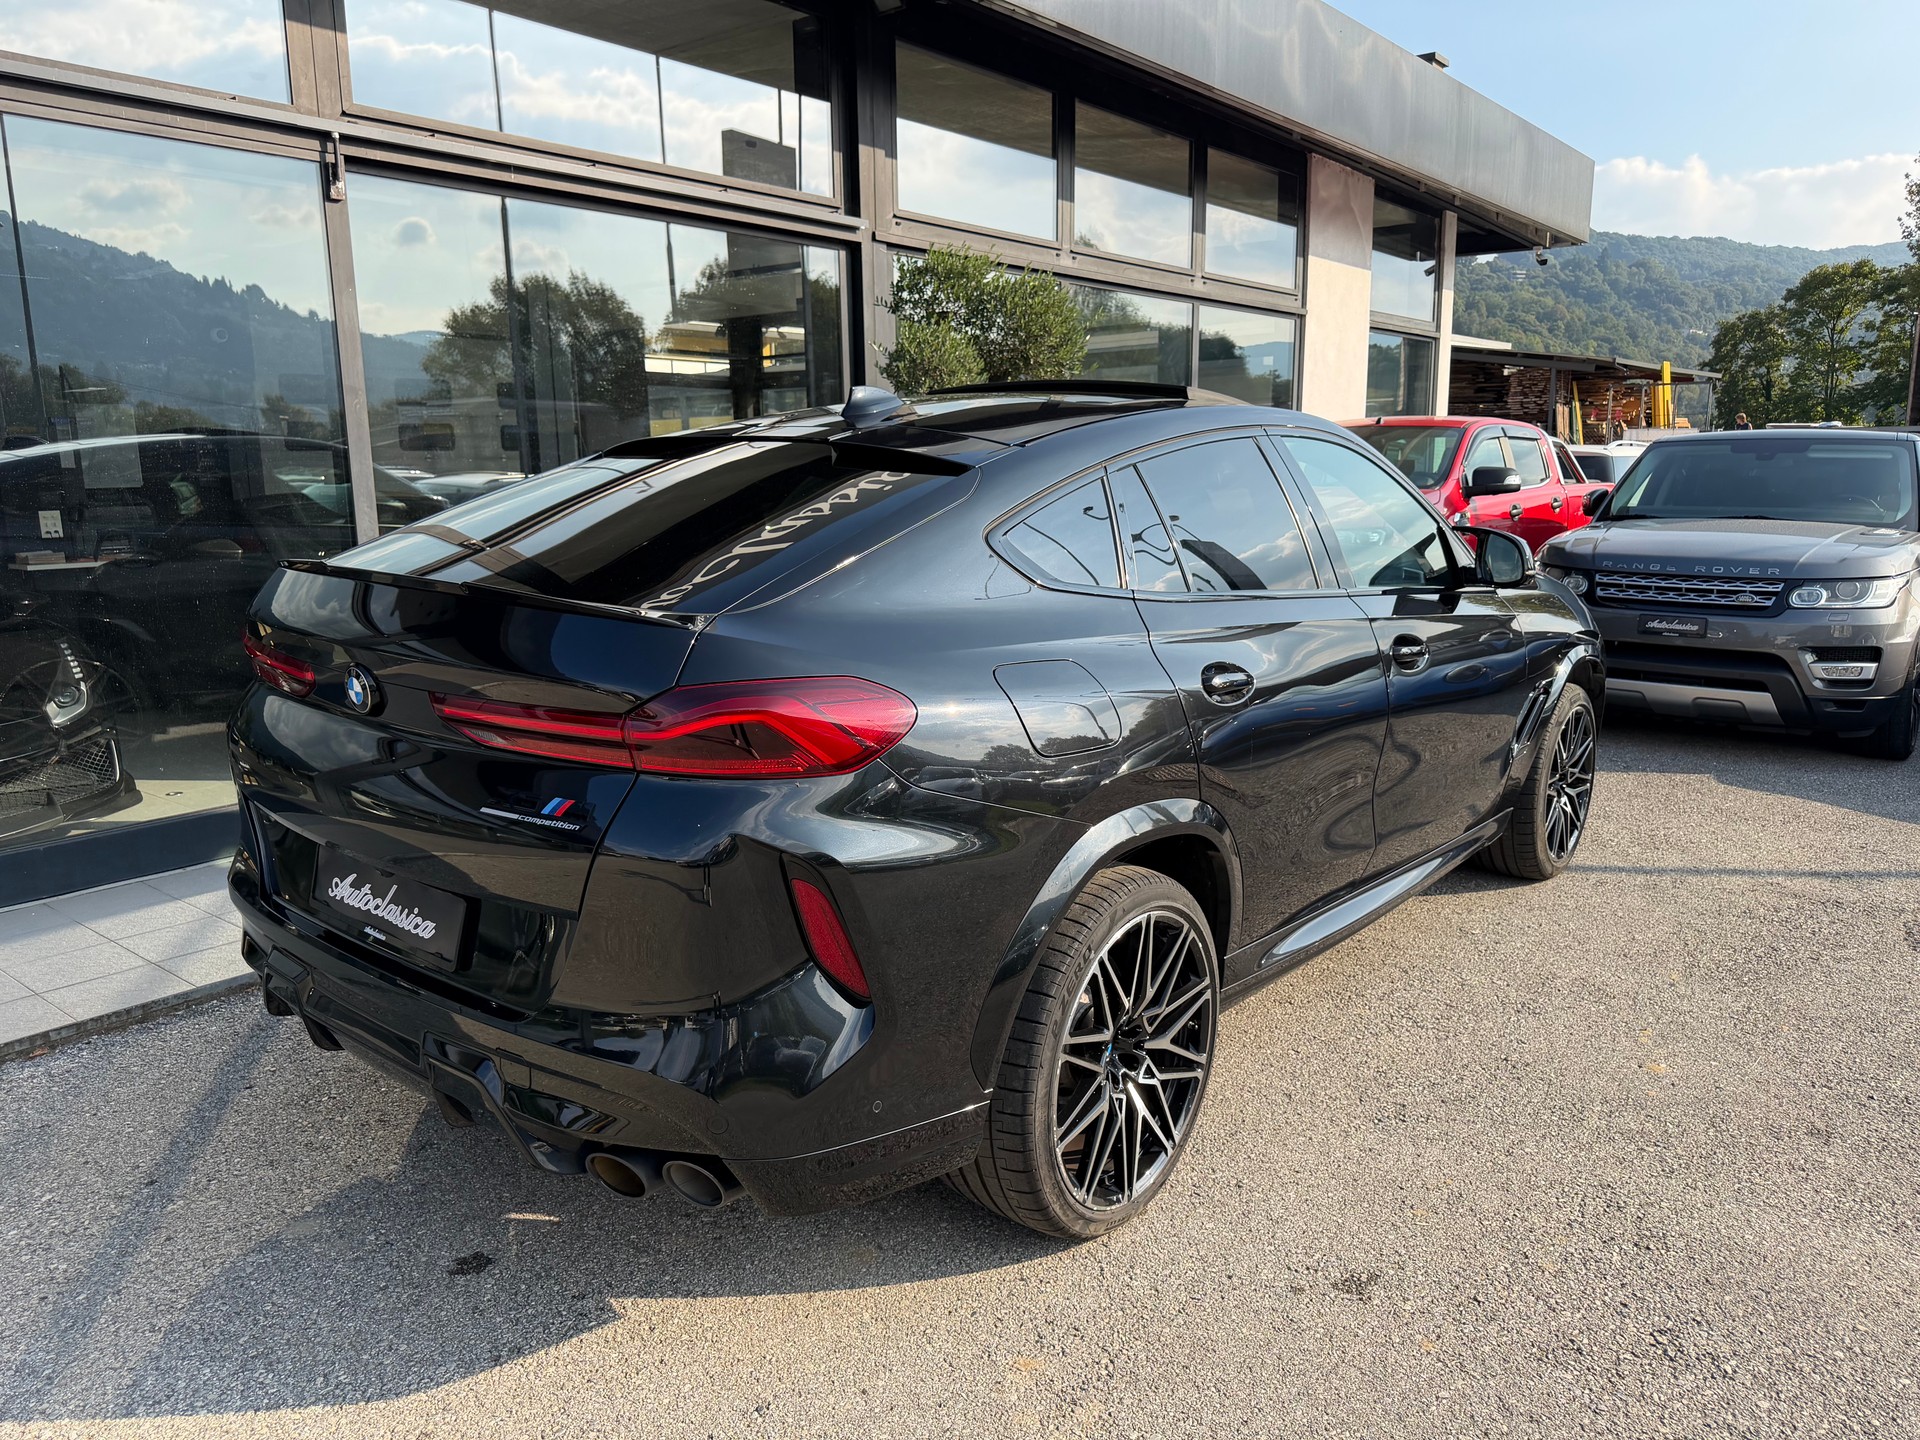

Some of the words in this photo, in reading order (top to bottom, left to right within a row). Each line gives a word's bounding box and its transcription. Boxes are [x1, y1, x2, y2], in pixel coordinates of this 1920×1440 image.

[1602, 560, 1677, 572] RANGE
[1694, 565, 1781, 575] ROVER
[1645, 619, 1699, 631] Autoclassica
[518, 814, 581, 831] competition
[328, 873, 436, 939] Autoclassica
[1059, 943, 1093, 1016] ZERO
